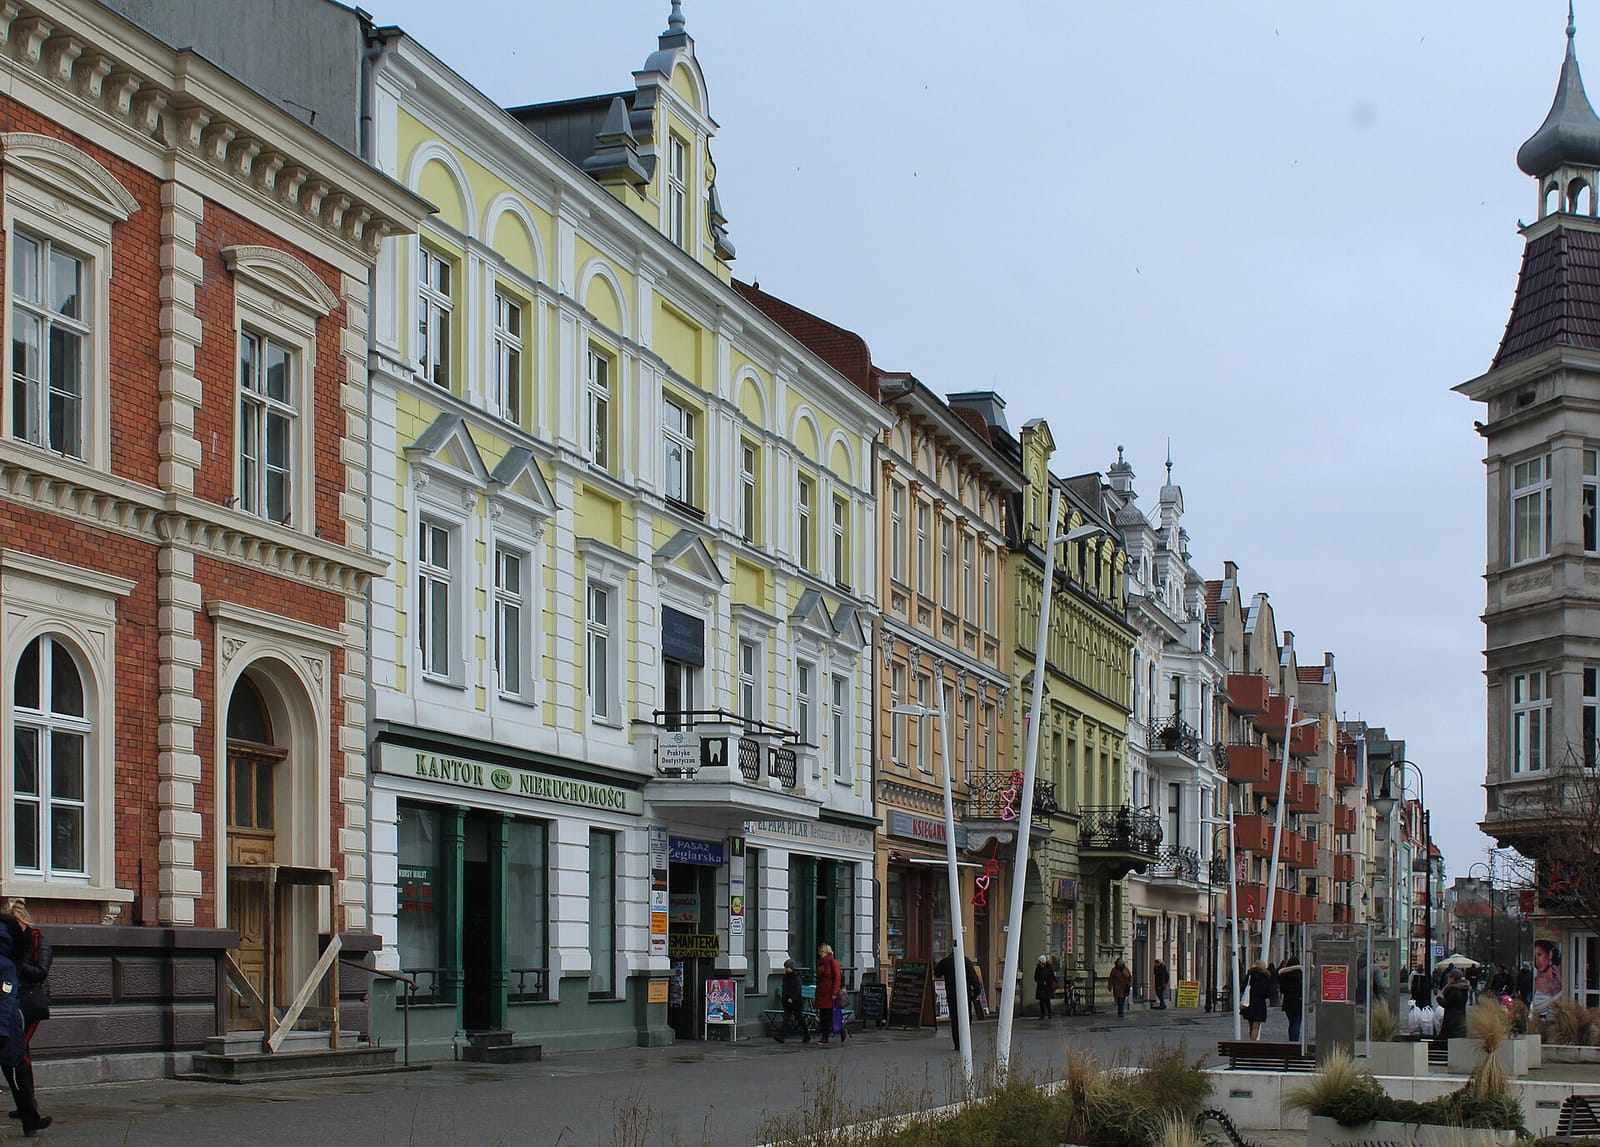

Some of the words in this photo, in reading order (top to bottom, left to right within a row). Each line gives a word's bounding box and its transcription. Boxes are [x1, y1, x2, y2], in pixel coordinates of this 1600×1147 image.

[667, 749, 690, 758] Praktyka
[661, 757, 696, 765] Dentystyczna
[416, 753, 484, 786] KANTOR
[519, 773, 627, 810] NIERUCHOMOŚCI
[787, 821, 808, 838] PILAR
[669, 935, 719, 949] SMANTERIA
